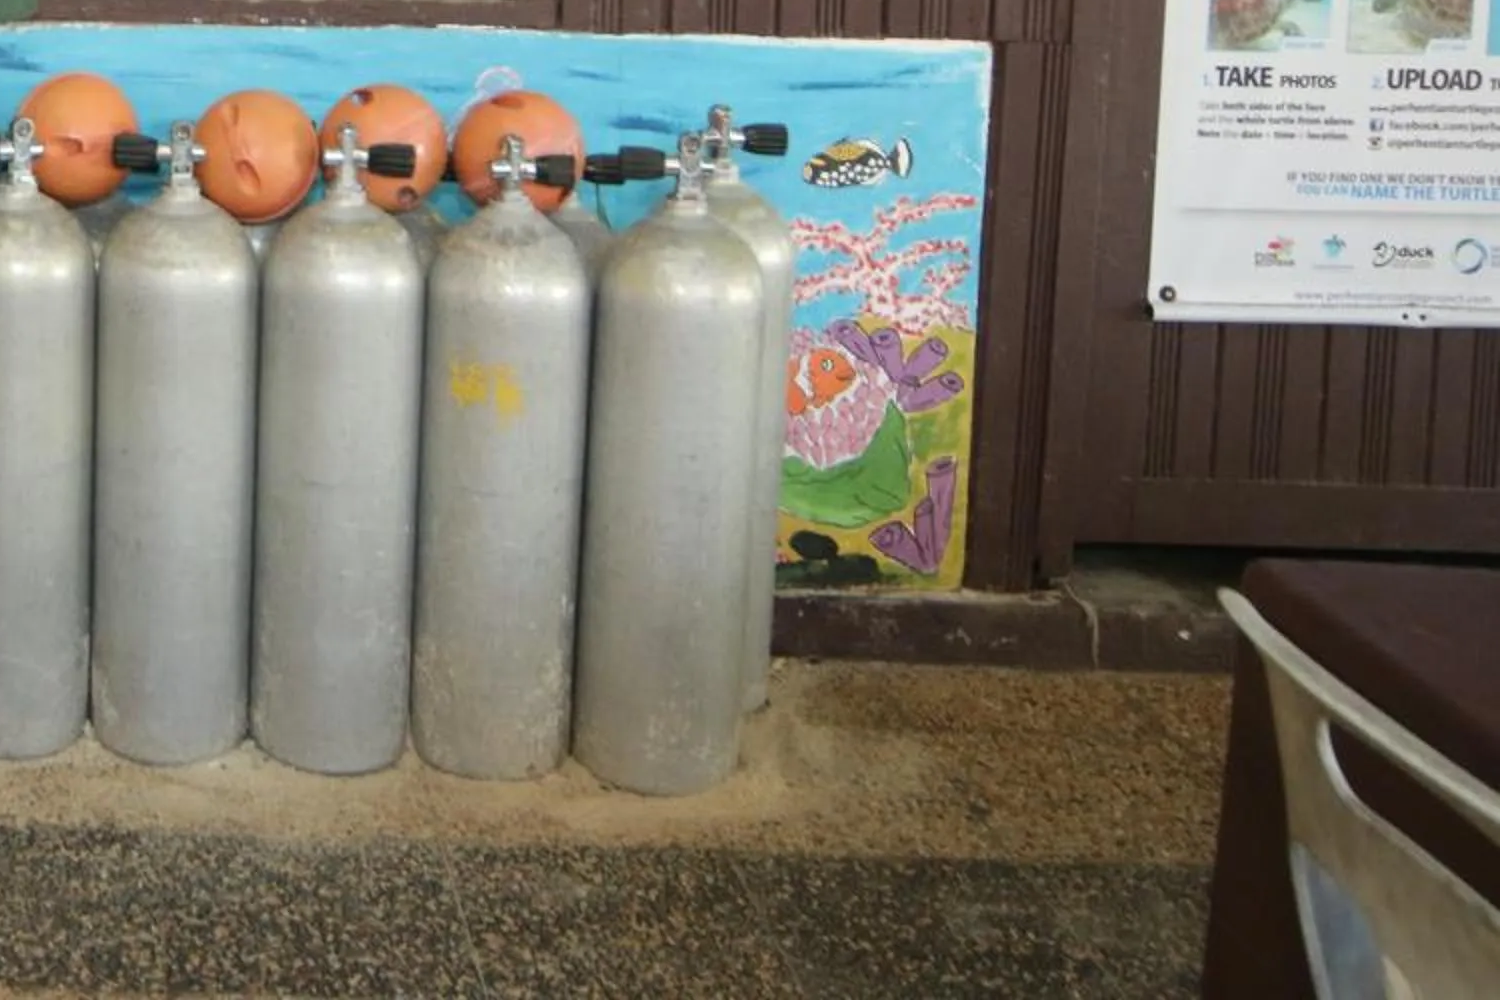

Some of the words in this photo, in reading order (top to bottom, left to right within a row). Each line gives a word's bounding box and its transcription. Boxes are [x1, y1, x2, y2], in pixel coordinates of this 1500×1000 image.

[1215, 65, 1274, 88] TAKE
[1279, 74, 1337, 89] PHOTOS
[1386, 66, 1483, 91] UPLOAD
[1350, 184, 1399, 200] NAME
[1404, 185, 1434, 201] THE
[1440, 186, 1500, 202] TURTLE
